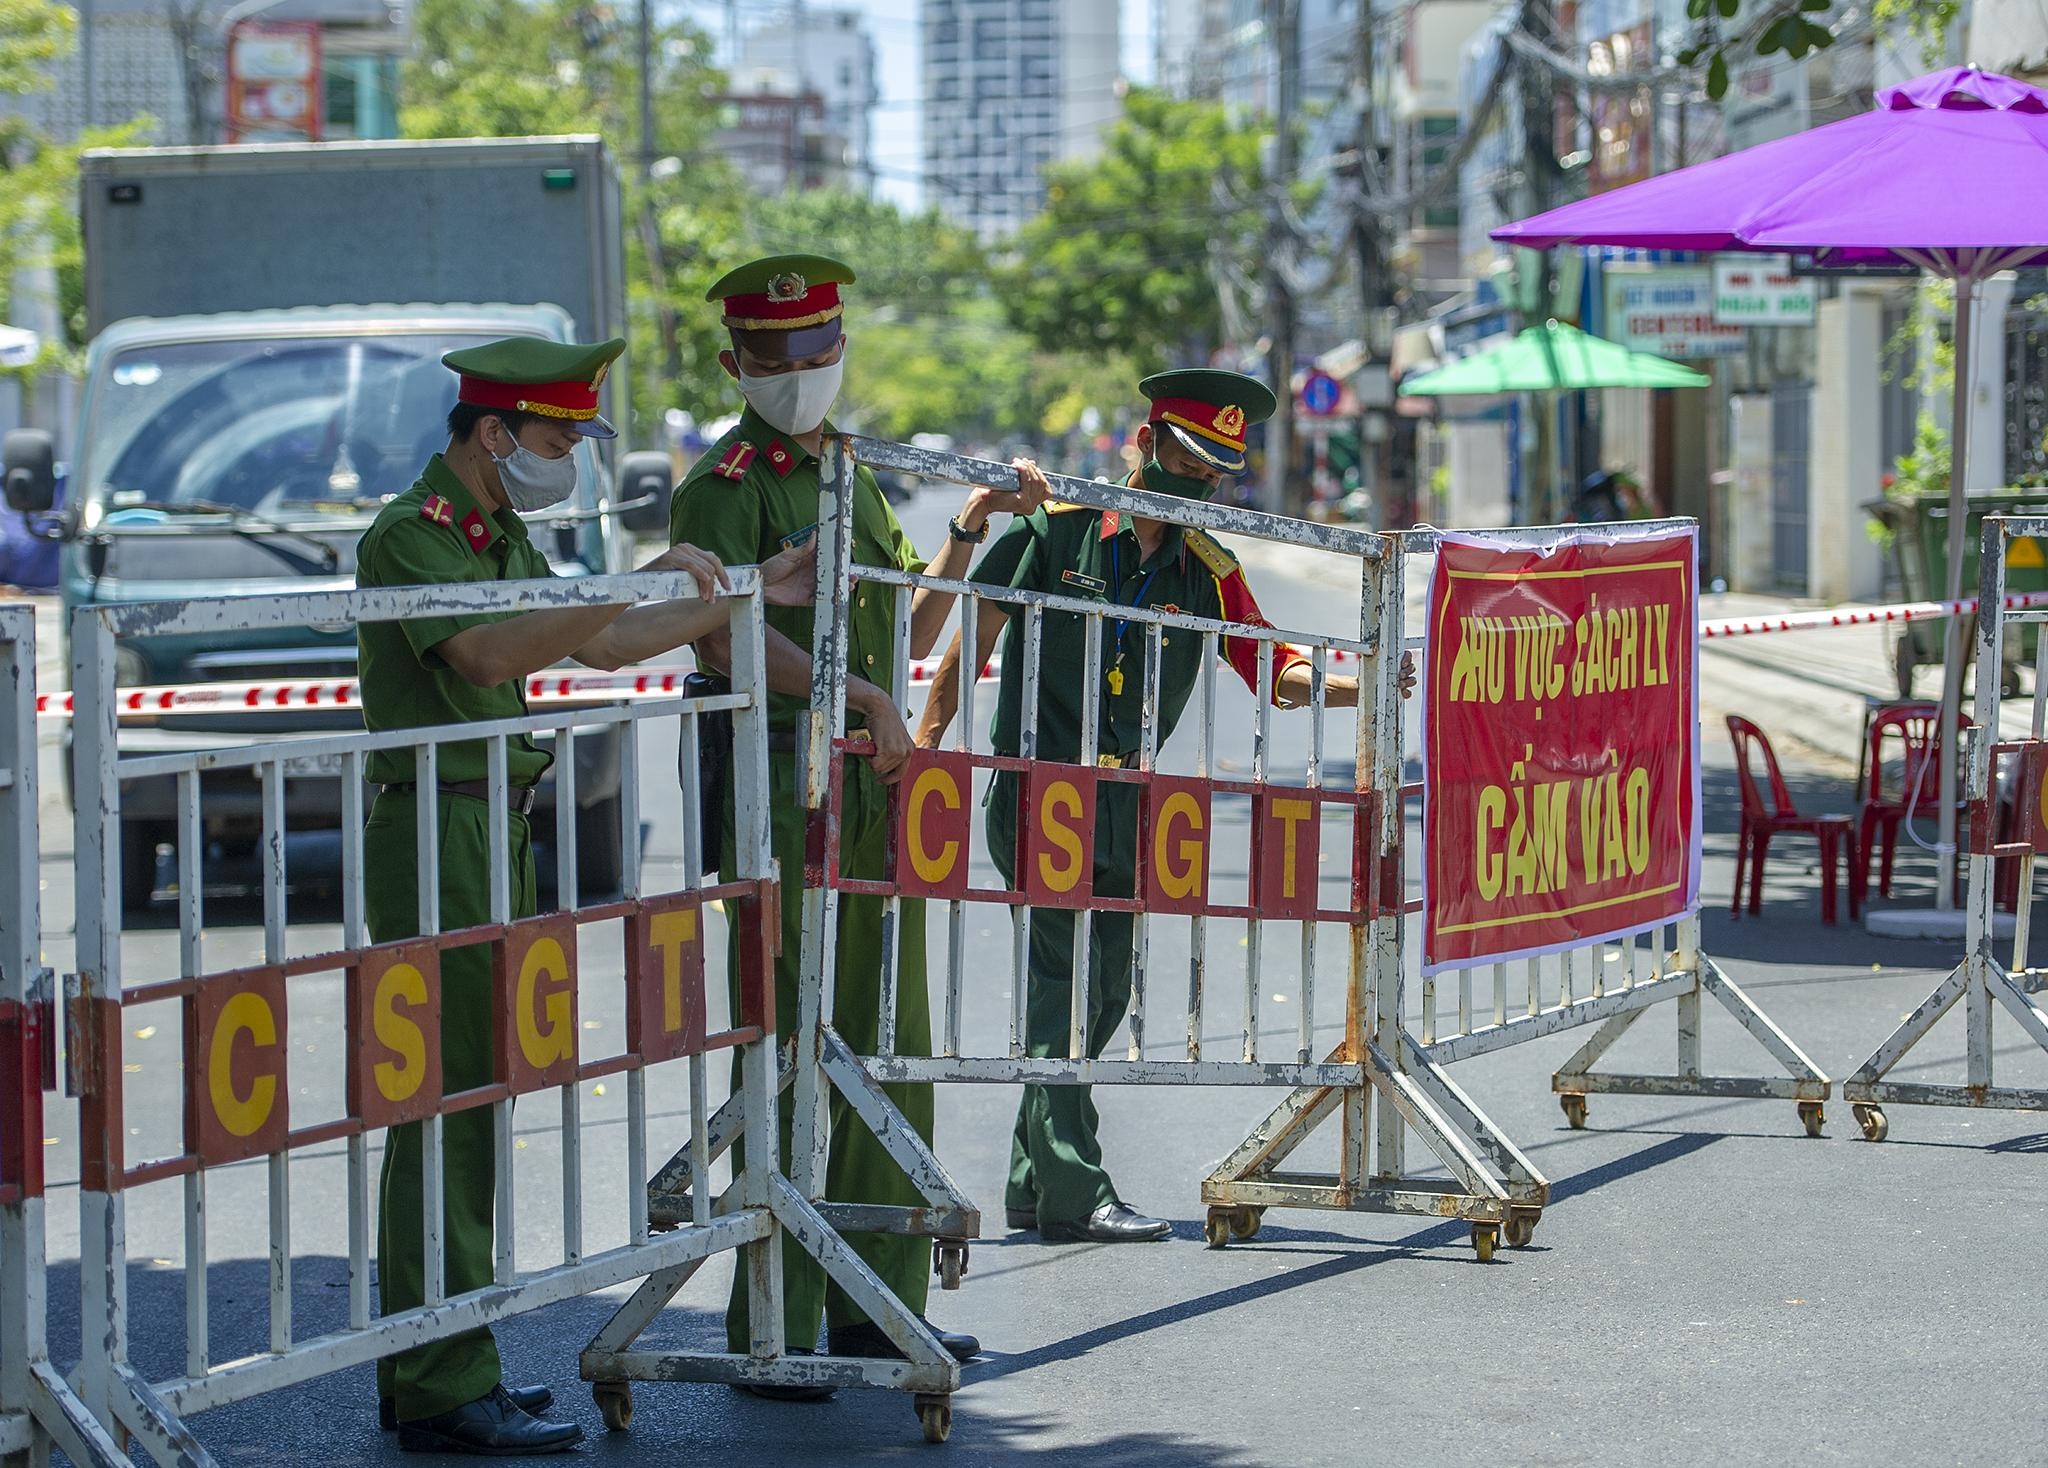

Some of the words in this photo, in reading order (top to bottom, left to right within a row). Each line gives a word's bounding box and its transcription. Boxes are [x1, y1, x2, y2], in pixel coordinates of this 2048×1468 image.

[1643, 604, 1670, 686] LY
[1476, 743, 1571, 901] CẤM
[1580, 749, 1650, 886] VÀO
